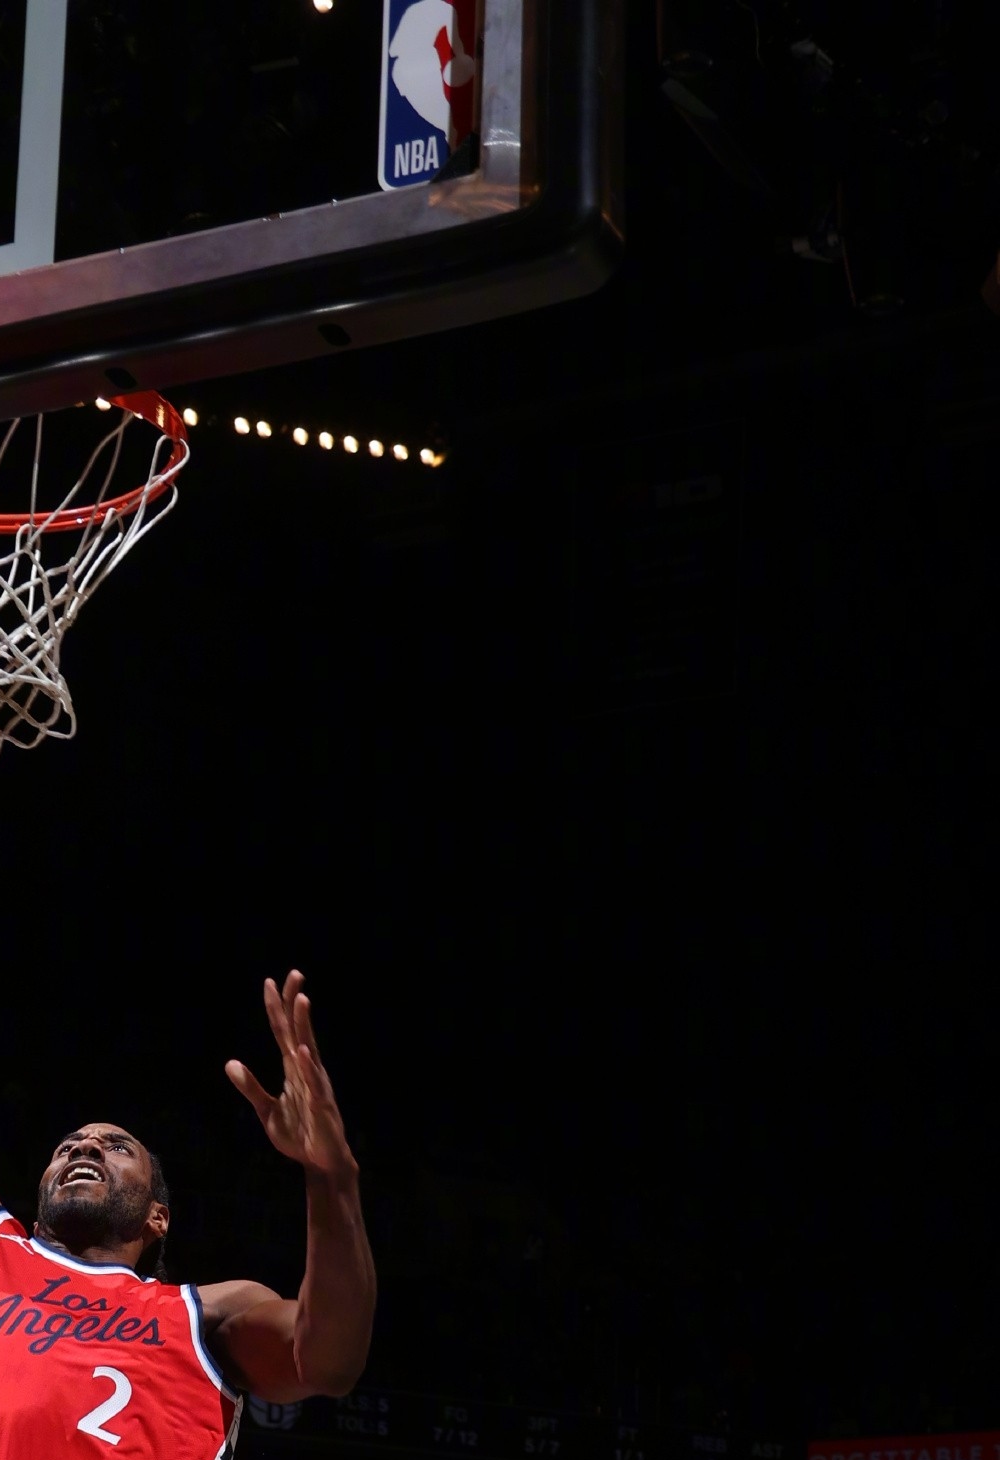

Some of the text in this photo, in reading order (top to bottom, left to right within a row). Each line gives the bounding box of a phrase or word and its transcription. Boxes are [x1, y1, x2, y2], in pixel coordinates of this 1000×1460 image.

[394, 136, 439, 179] NBA
[31, 1276, 110, 1312] Los
[77, 1367, 133, 1447] 2
